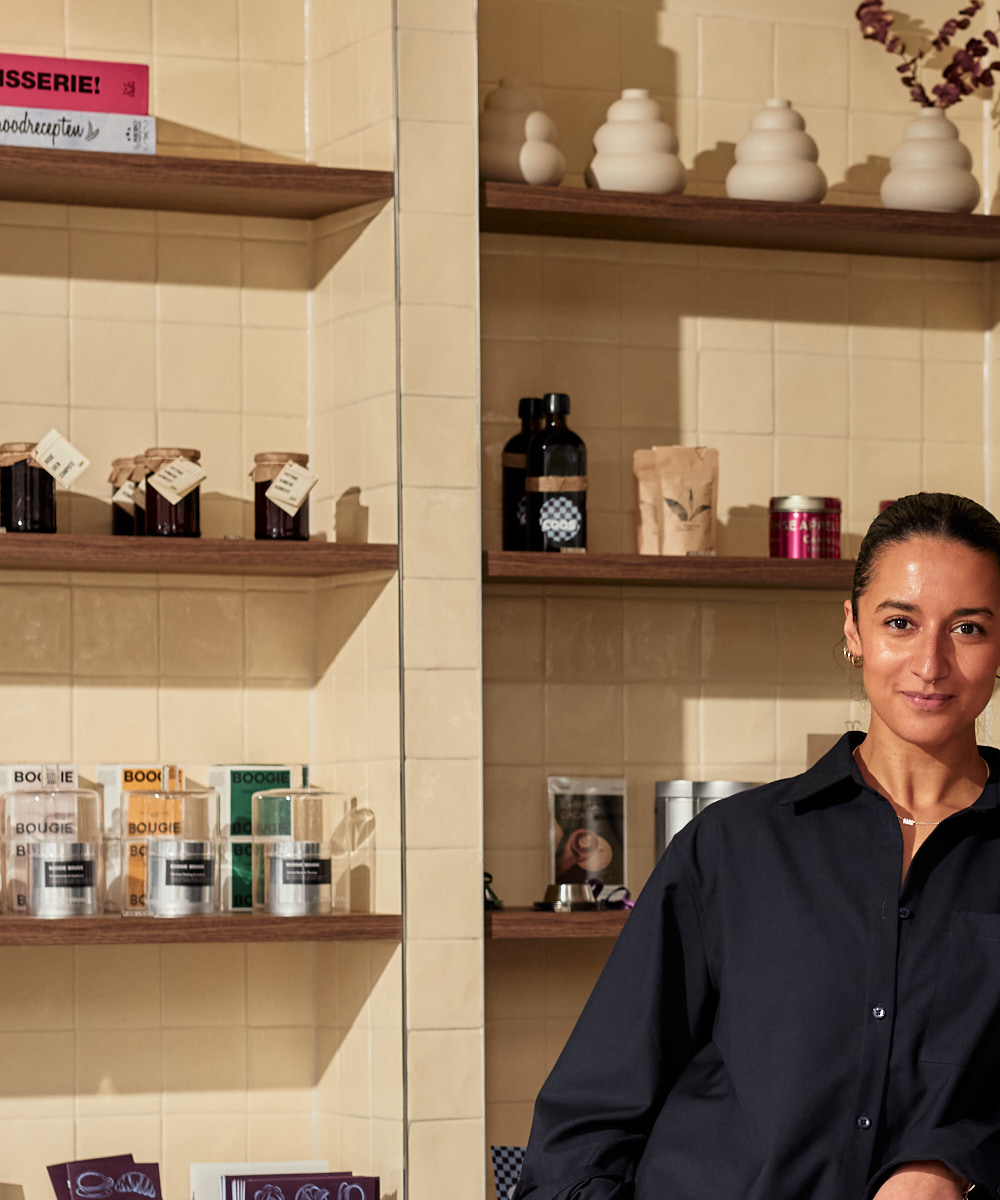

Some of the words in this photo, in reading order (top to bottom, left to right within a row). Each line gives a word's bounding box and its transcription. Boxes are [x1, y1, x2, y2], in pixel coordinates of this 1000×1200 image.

[0, 111, 84, 146] oodrecepten
[14, 771, 73, 783] BOIE
[232, 772, 288, 784] BOOGIE
[16, 822, 73, 834] BOUGIE
[128, 822, 181, 834] BOUGIE
